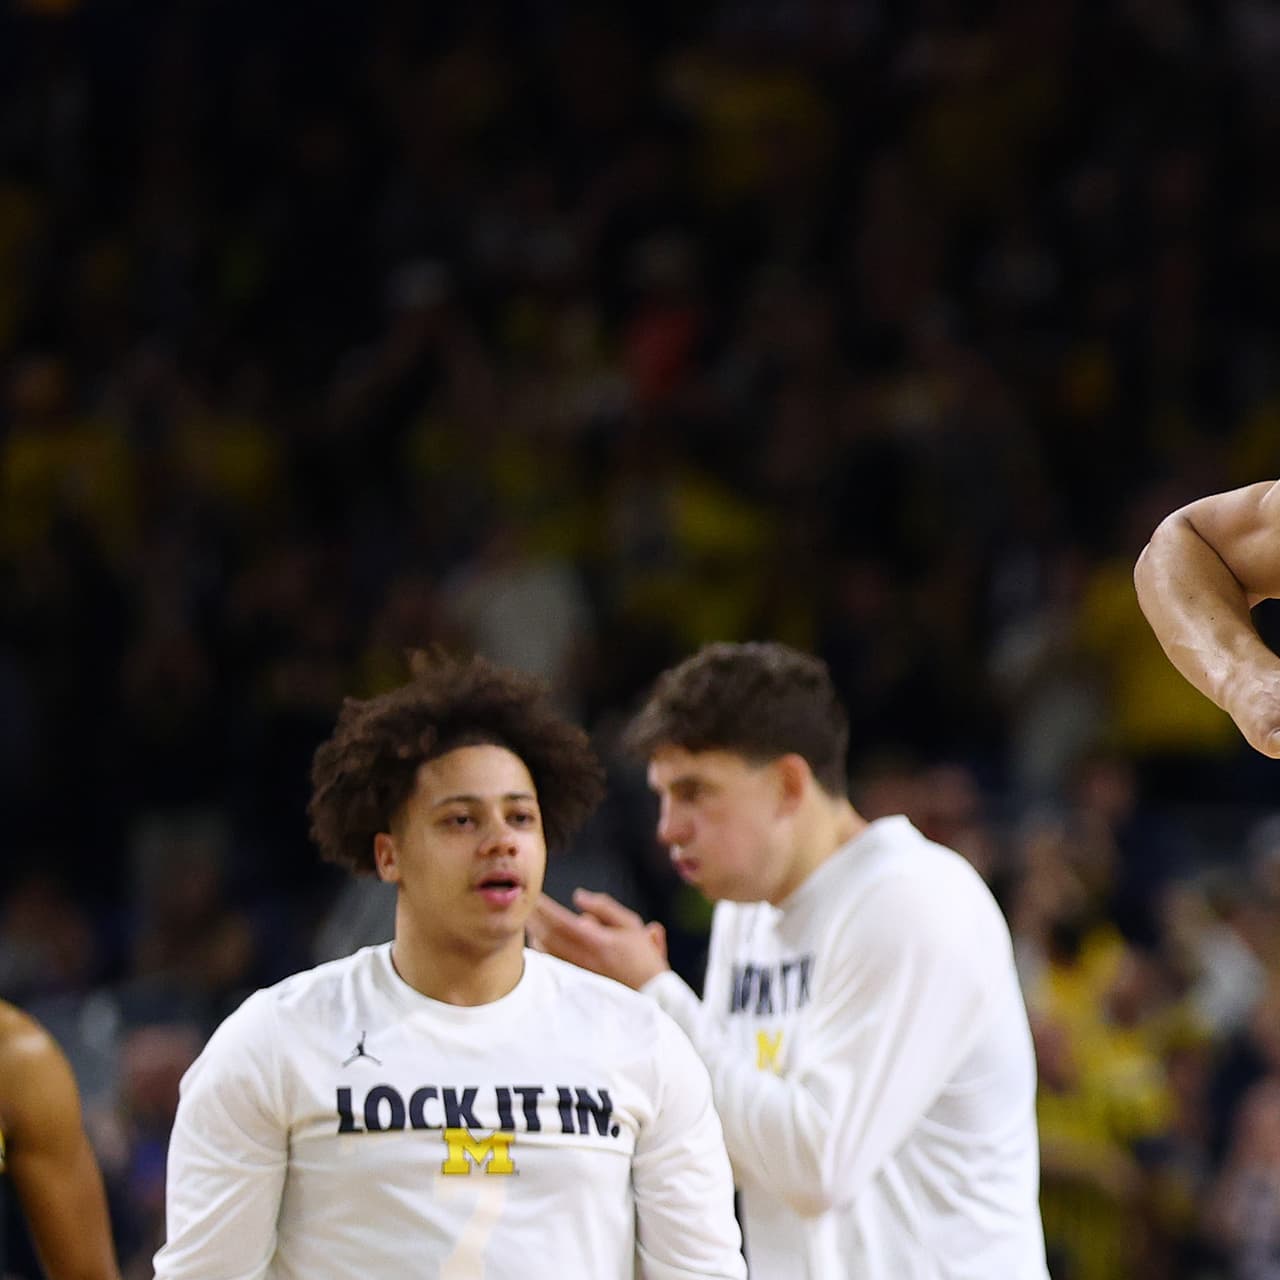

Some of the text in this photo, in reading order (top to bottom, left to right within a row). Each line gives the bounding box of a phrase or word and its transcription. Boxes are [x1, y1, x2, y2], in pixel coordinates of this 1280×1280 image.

[335, 1084, 621, 1139] LOCK IT IN.
[441, 1127, 516, 1175] M
